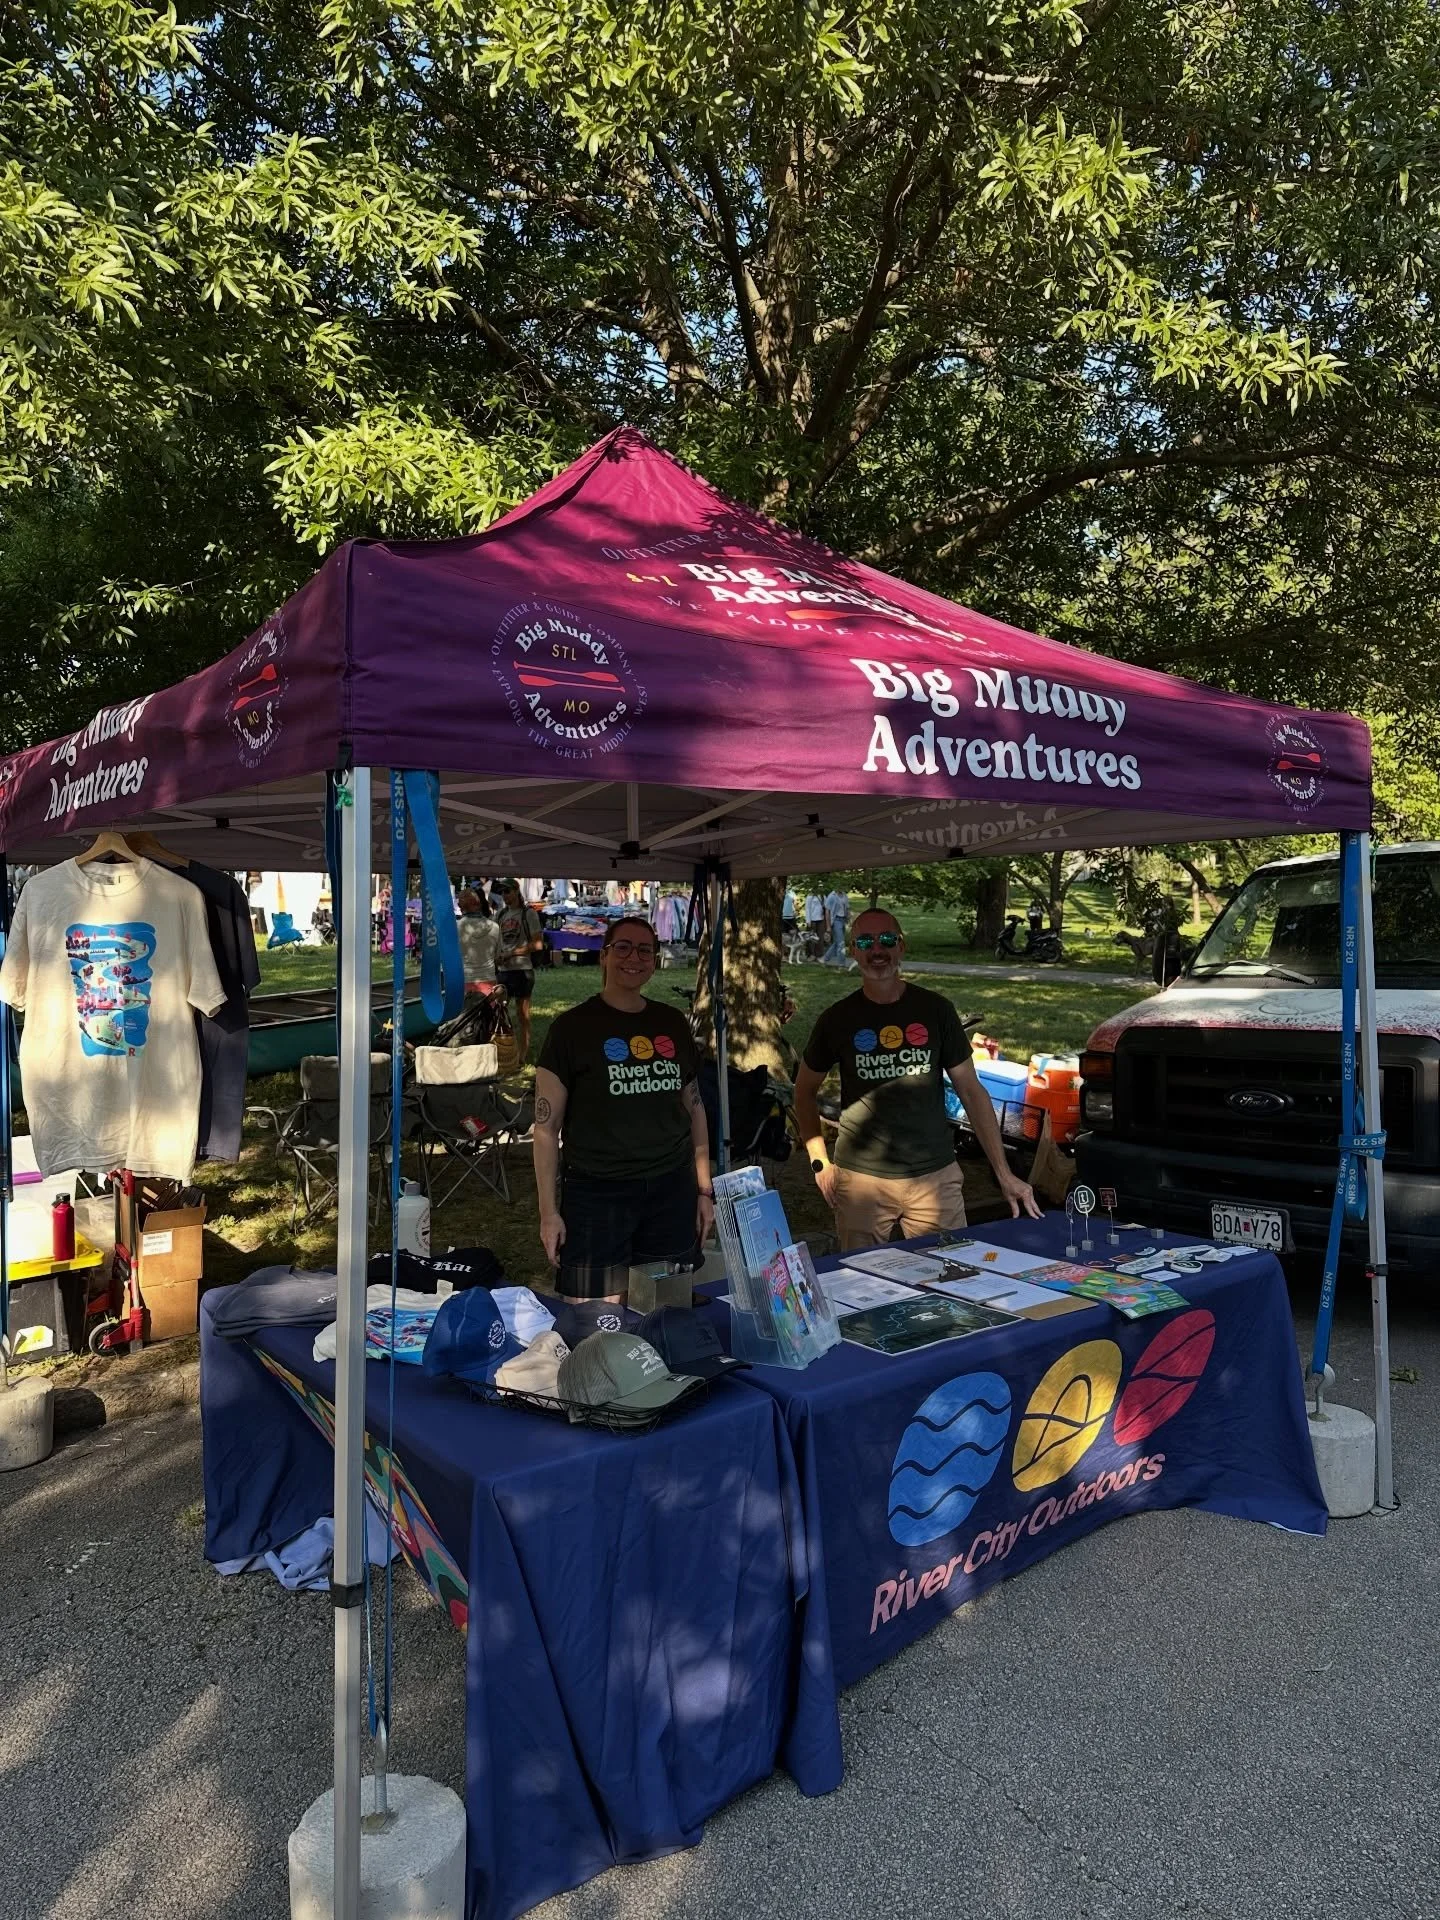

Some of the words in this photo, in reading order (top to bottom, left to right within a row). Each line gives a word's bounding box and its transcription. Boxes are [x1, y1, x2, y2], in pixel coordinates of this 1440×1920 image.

[601, 534, 708, 560] OUTFITTER
[678, 563, 778, 587] Big
[657, 595, 706, 612] WE
[726, 609, 853, 636] PADDLE
[491, 601, 530, 656] OUTFITTER
[545, 603, 582, 623] GUIDE
[588, 623, 634, 676] COMPANY
[515, 621, 548, 652] Big
[547, 618, 609, 665] Muddy
[552, 643, 577, 661] STL
[492, 668, 526, 727] EXPLORE
[528, 728, 551, 749] THE
[555, 745, 594, 759] GREAT
[599, 721, 633, 755] MIDDLE
[633, 684, 648, 717] WEST
[524, 691, 627, 740] Adventures
[564, 699, 590, 714] MO
[850, 659, 959, 717] Big
[960, 668, 1126, 736] Muddy
[82, 693, 155, 750] Muddy
[862, 715, 1141, 790] Adventures
[44, 757, 148, 821] Adventures
[607, 1064, 650, 1080] River
[652, 1060, 680, 1078] City
[855, 1053, 896, 1068] River
[899, 1048, 932, 1064] City
[857, 1064, 932, 1080] Outdoors
[609, 1077, 682, 1095] Outdoors
[1251, 1218, 1280, 1241] Y78
[869, 1552, 964, 1635] River
[963, 1513, 1029, 1575] City
[1028, 1453, 1166, 1537] Outdoors
